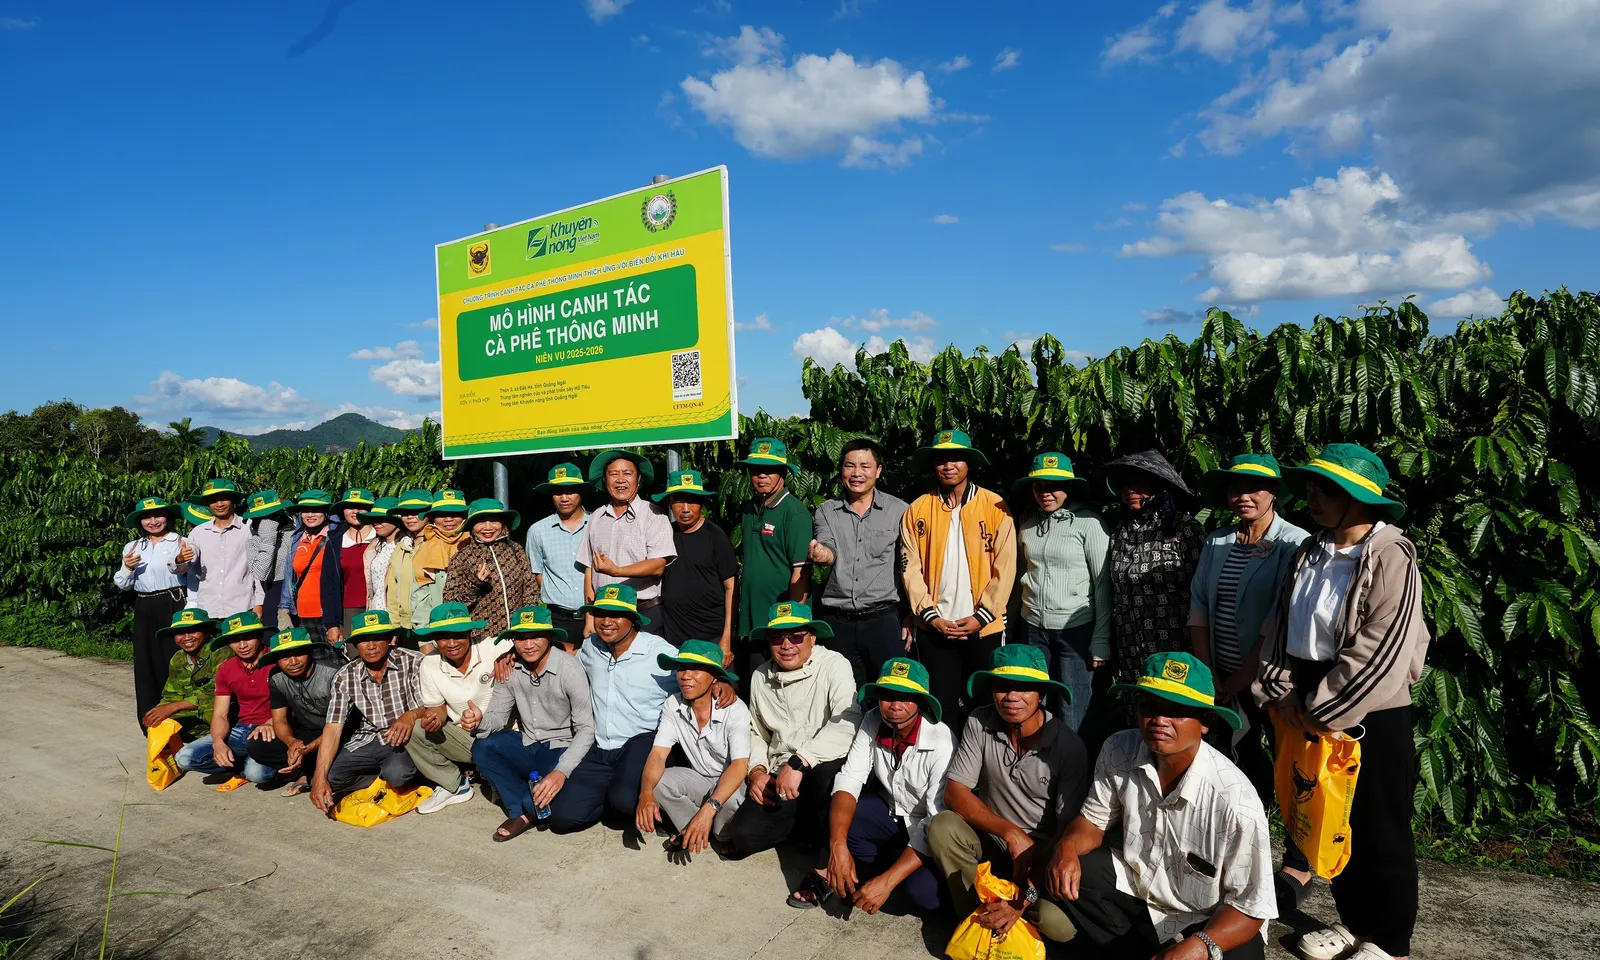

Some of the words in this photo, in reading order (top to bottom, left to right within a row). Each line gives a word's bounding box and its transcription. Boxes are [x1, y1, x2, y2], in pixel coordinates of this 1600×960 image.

[549, 237, 577, 254] nông
[490, 308, 513, 332] MÔ
[517, 303, 555, 327] HÌNH
[560, 291, 608, 318] CANH
[613, 281, 651, 308] TÁC
[485, 333, 506, 356] CÀ
[510, 326, 542, 352] PHÊ
[546, 319, 606, 346] THÔNG
[612, 309, 659, 335] MINH
[535, 350, 553, 364] NIÊN
[554, 349, 565, 362] VỤ
[567, 345, 604, 359] 2025-2026
